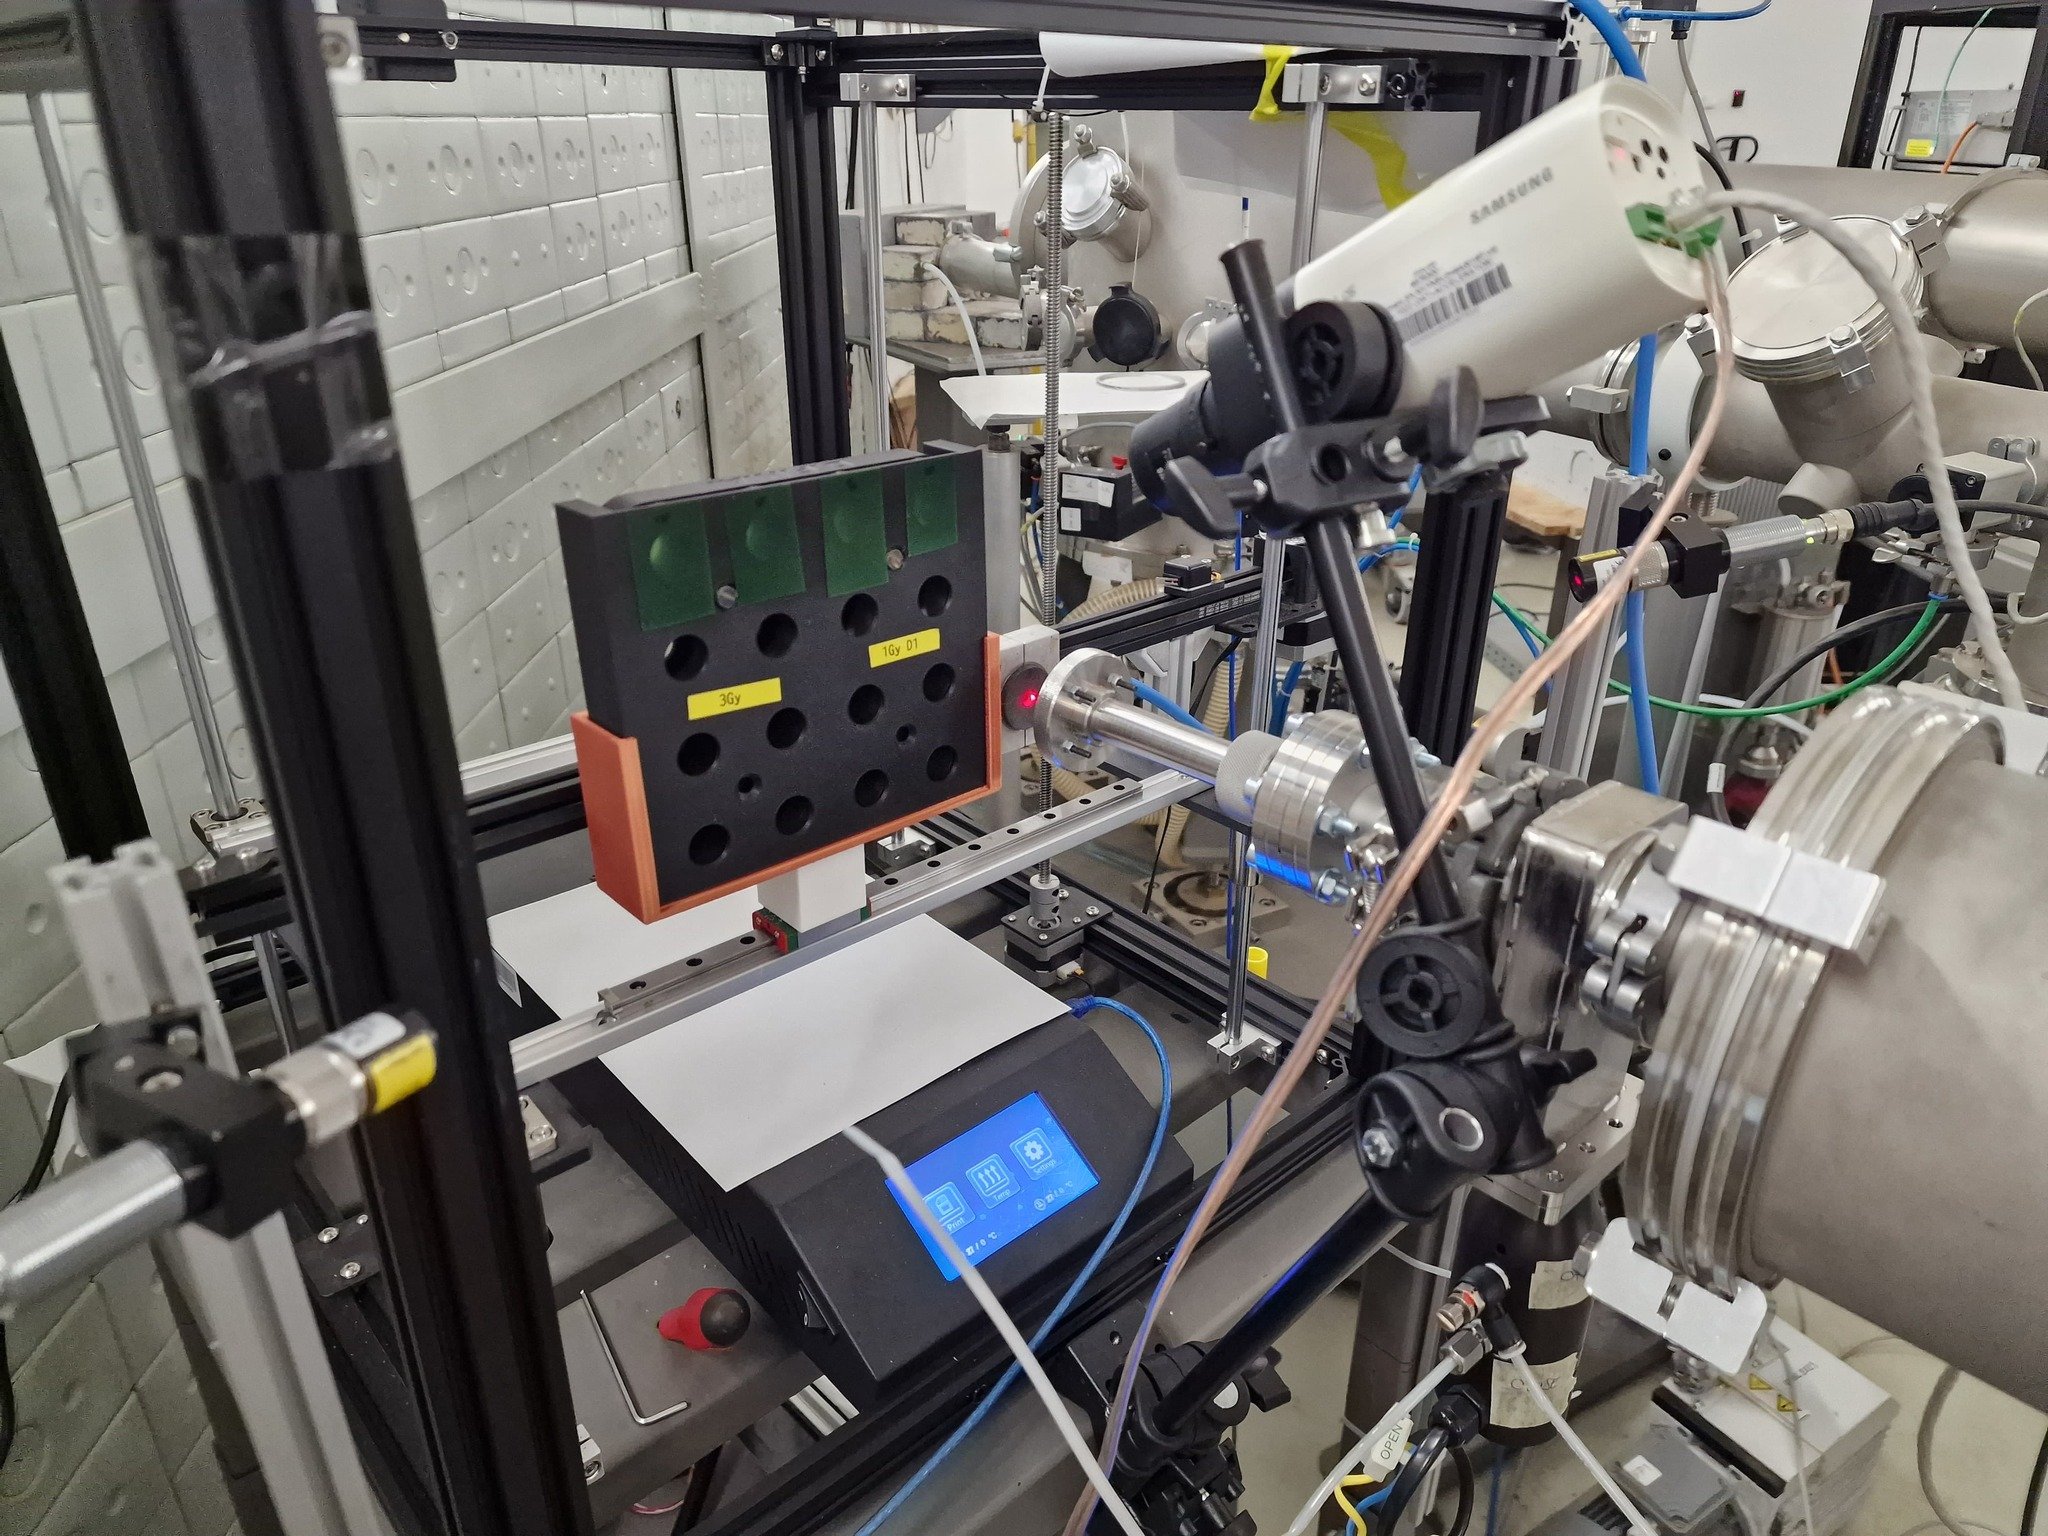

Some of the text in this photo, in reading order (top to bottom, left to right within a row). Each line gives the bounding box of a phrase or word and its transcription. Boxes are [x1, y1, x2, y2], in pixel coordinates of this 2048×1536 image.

[1470, 167, 1553, 224] SAMSUNG
[883, 644, 901, 656] 1Gy
[720, 692, 741, 707] 3Gy
[993, 1189, 1011, 1201] Temp
[946, 1217, 965, 1231] Print
[1380, 1424, 1403, 1460] OPEN
